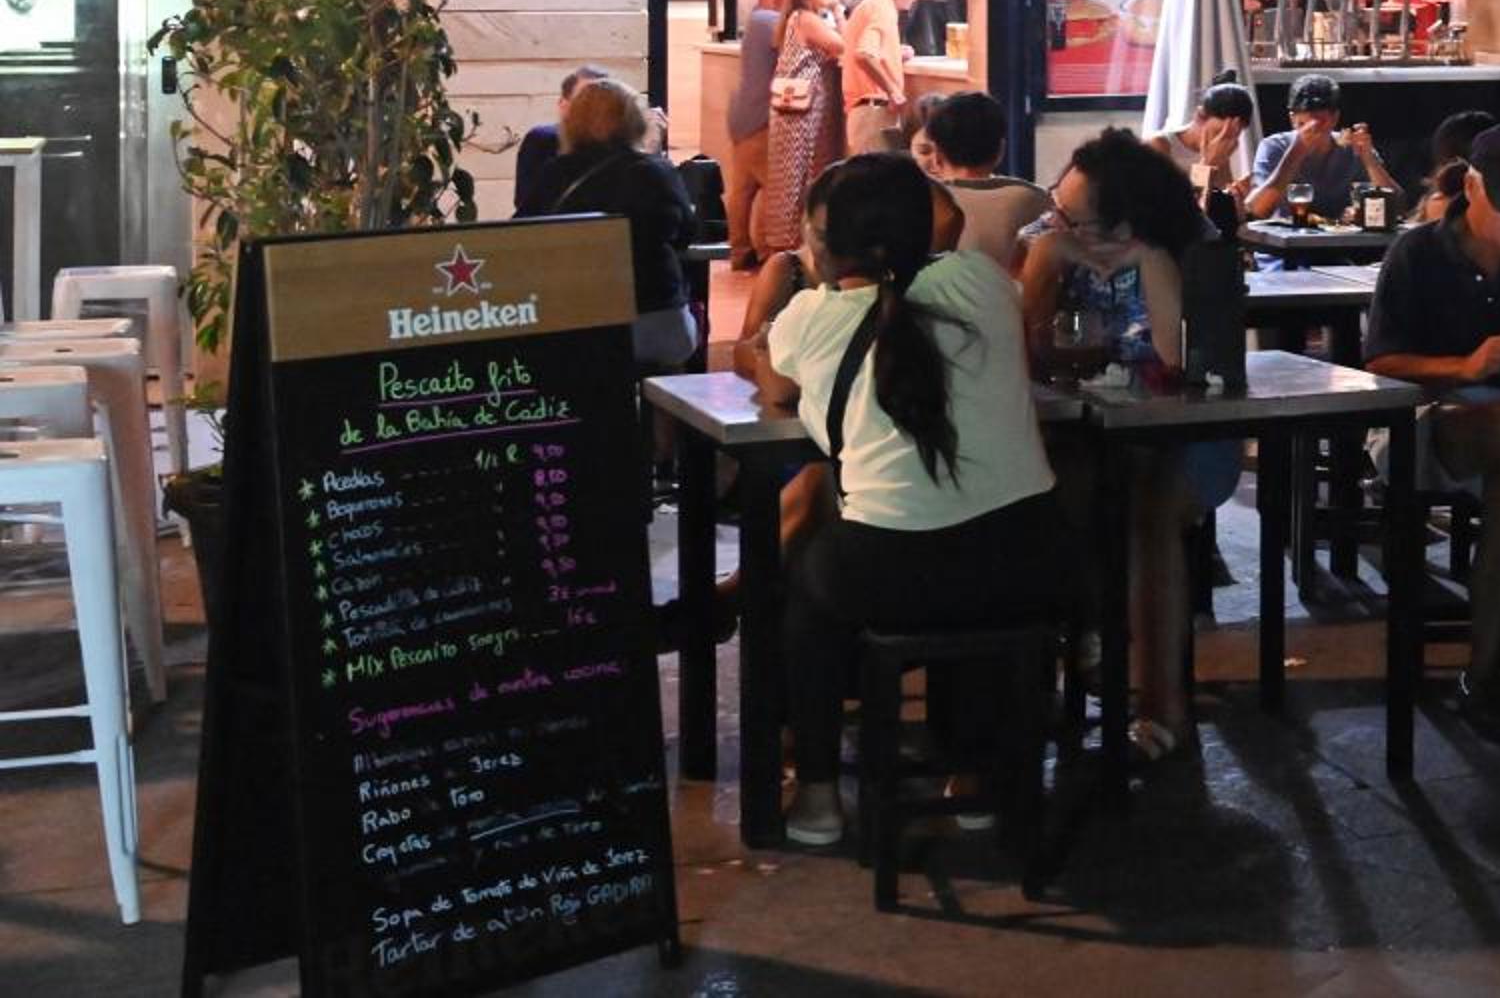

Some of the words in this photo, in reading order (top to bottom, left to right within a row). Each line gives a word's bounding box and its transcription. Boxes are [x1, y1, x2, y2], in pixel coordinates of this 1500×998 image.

[388, 300, 538, 339] Heineken
[486, 356, 532, 407] frito
[339, 417, 364, 446] de
[376, 413, 401, 438] la
[474, 405, 496, 425] de
[359, 774, 431, 803] Riñones
[361, 807, 411, 835] Rabo
[371, 906, 424, 933] Sopa
[430, 895, 453, 913] de
[541, 866, 578, 884] Viña
[581, 860, 602, 876] de
[371, 929, 443, 969] Tartar
[452, 921, 478, 942] de
